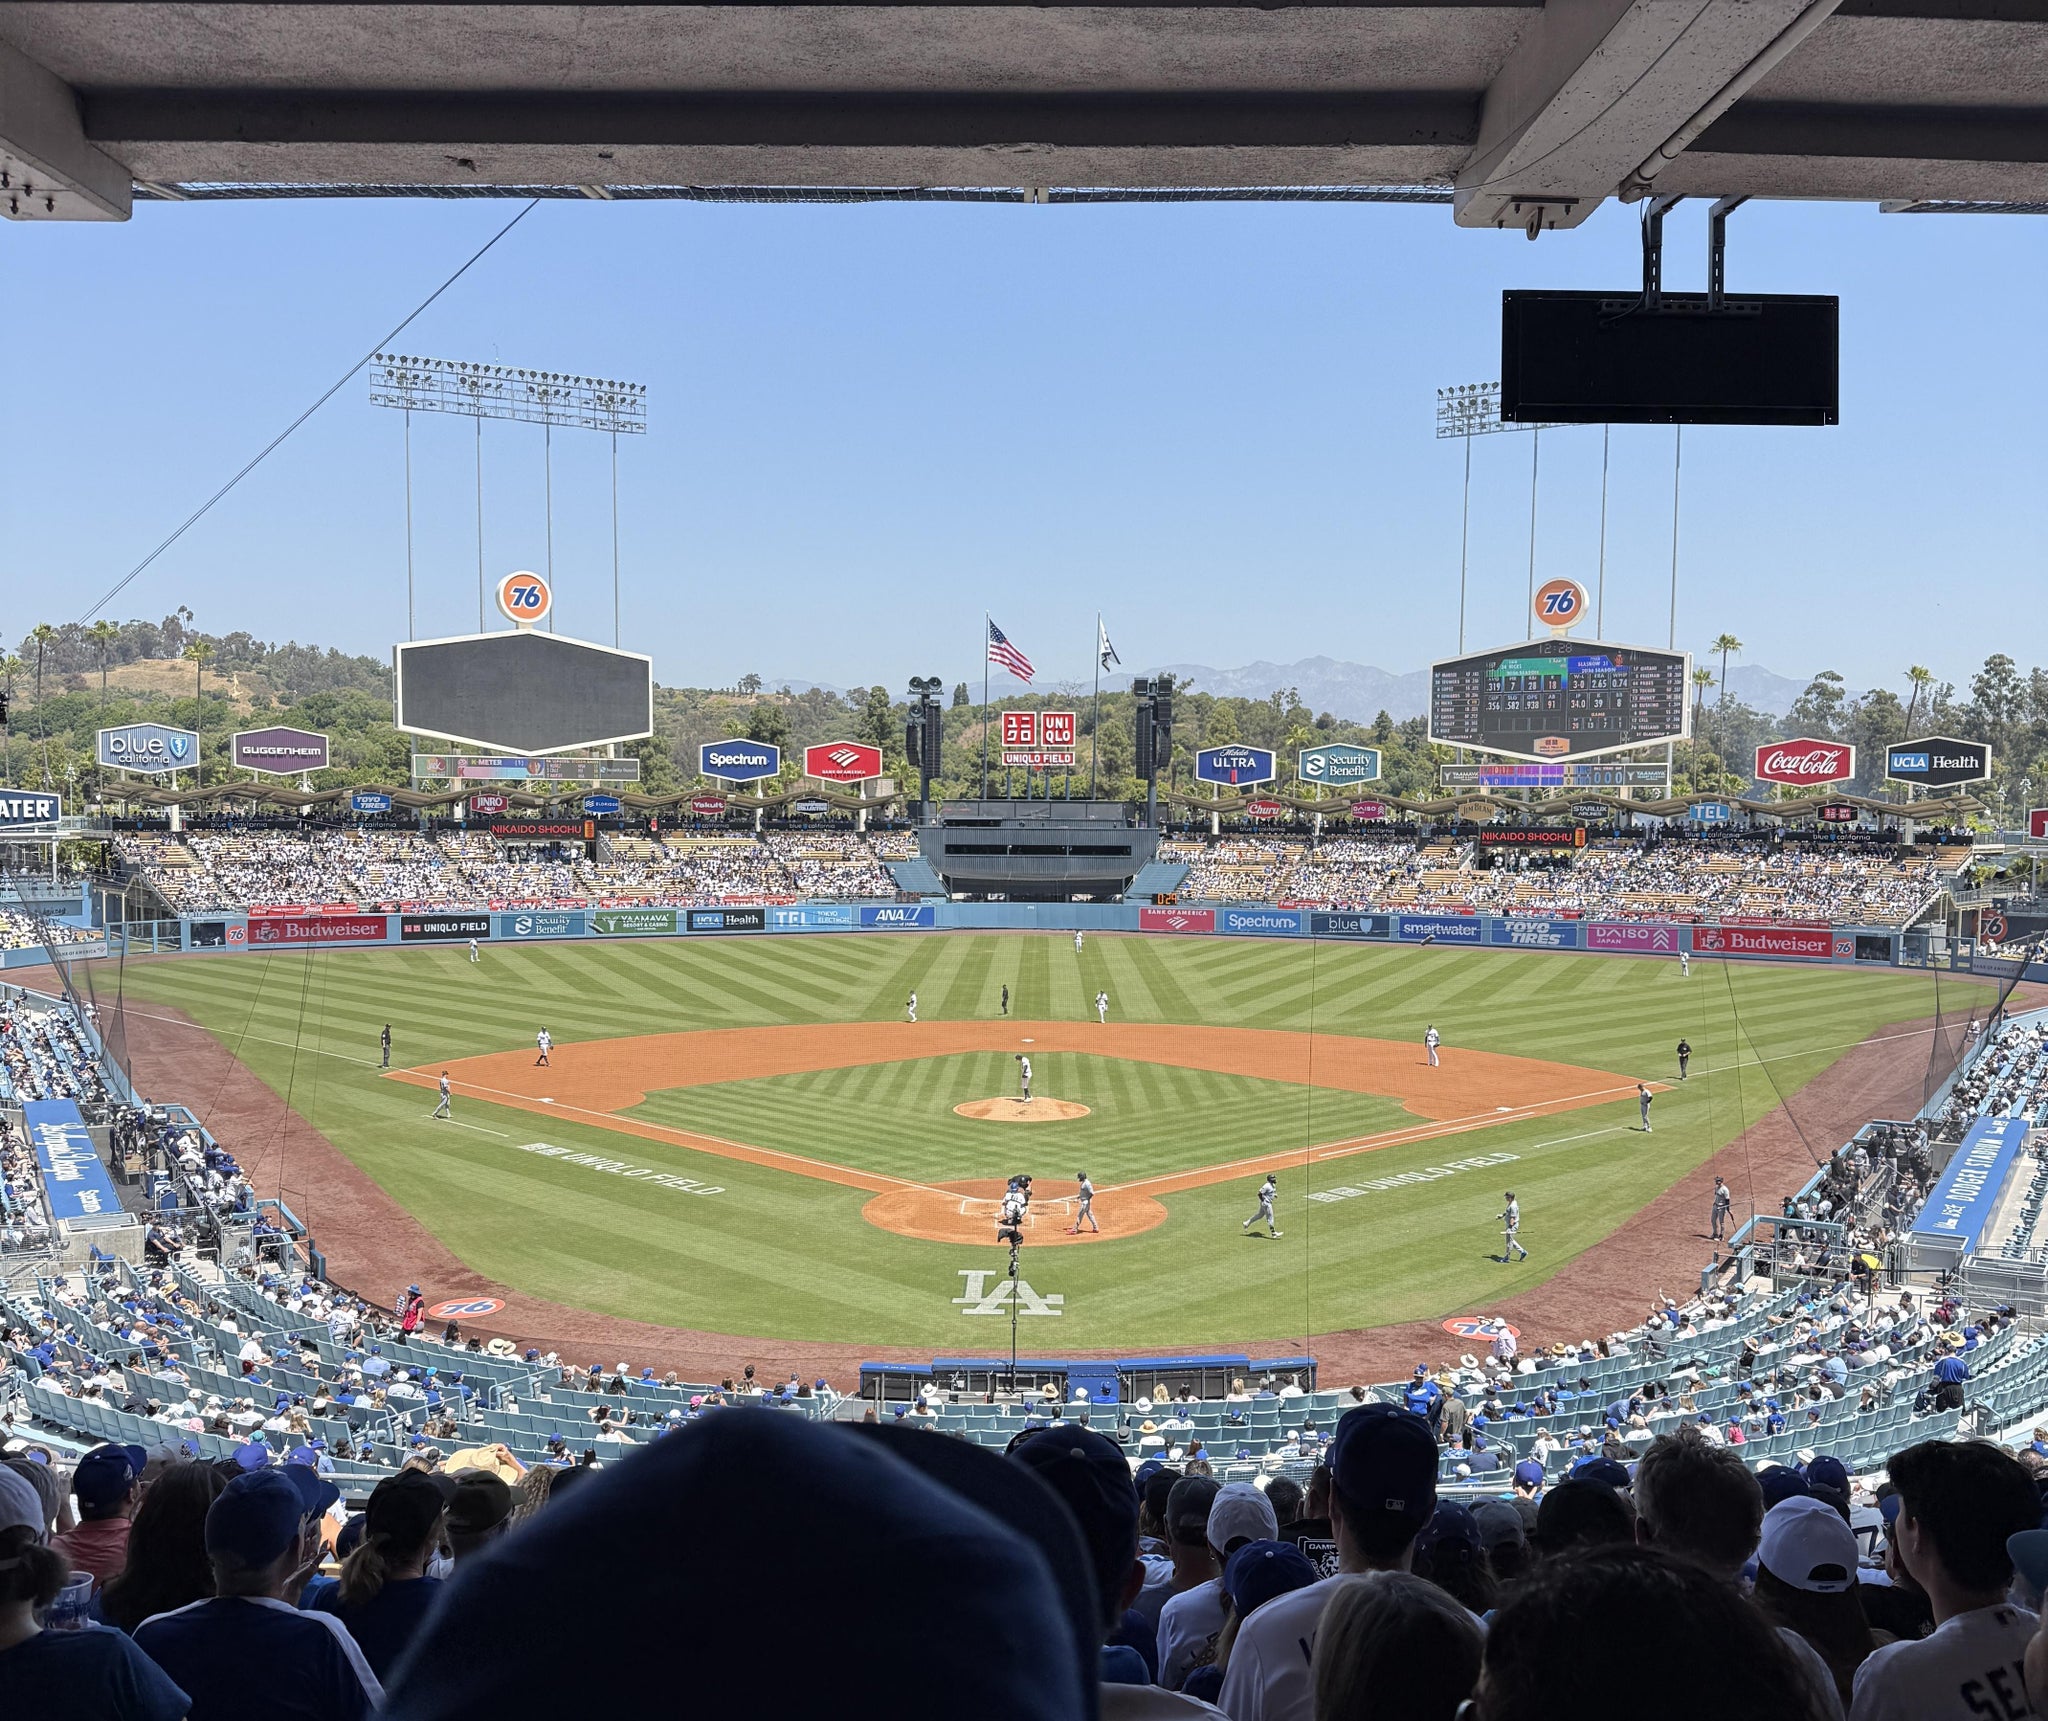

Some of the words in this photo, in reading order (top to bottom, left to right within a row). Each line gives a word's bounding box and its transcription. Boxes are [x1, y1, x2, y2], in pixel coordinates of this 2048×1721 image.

[511, 585, 541, 608] 76
[1543, 589, 1575, 615] 76
[1540, 643, 1573, 654] 12:28
[1486, 683, 1501, 692] .319
[1510, 682, 1516, 691] 7
[1528, 682, 1537, 690] 28
[1592, 680, 1607, 688] 2.65
[1612, 679, 1628, 687] 0.74
[1485, 701, 1500, 710] .356
[1505, 701, 1520, 710] .582
[1525, 701, 1539, 710] .938
[1594, 699, 1603, 708] 39
[1007, 716, 1032, 728] ユニ
[1045, 717, 1069, 729] UNI
[1006, 730, 1031, 741] クロ
[1045, 730, 1071, 743] QLO
[110, 731, 164, 754] blue
[242, 746, 321, 756] GUGGENHEIM
[118, 754, 170, 764] california
[709, 753, 768, 767] Spectrum
[1006, 754, 1041, 765] UNIQLO
[1043, 754, 1071, 763] FIELD
[1213, 757, 1256, 768] ULTRA
[1329, 754, 1371, 766] Security
[1763, 750, 1843, 775] Coca-Cola
[1893, 757, 1926, 768] UCLA
[1933, 756, 1979, 769] Health
[1329, 765, 1366, 776] Benefit
[1594, 772, 1601, 784] 0
[1604, 772, 1611, 784] 0
[1615, 772, 1622, 784] 0
[477, 797, 503, 807] JINRO
[693, 801, 724, 809] Yakult
[1249, 803, 1280, 815] Churu
[1461, 805, 1474, 817] JIM
[1474, 803, 1493, 815] BEAM
[1694, 805, 1725, 819] TEL
[492, 825, 536, 834] NIKAIDO
[538, 825, 582, 834] SHOCHU
[1481, 832, 1525, 841] NIKAIDO
[1527, 832, 1573, 842] SHOCHU
[536, 914, 571, 925] Security
[697, 916, 720, 926] UCLA
[726, 915, 759, 926] Health
[775, 911, 811, 927] TEL
[875, 909, 904, 921] ANA
[424, 923, 458, 933] UNIQLO
[461, 922, 488, 931] FIELD
[1229, 914, 1293, 929] Spectrum
[1329, 917, 1358, 930] blue
[1504, 921, 1550, 933] TOYO
[229, 929, 245, 940] 76
[285, 923, 379, 938] Budweiser
[536, 924, 566, 934] Benefit
[1404, 923, 1477, 937] smartwater
[1596, 928, 1649, 939] DAISO
[1511, 933, 1561, 945] TIRES
[1730, 932, 1827, 952] Budweiser
[1836, 942, 1852, 954] 76
[562, 1152, 653, 1176] UNIQLO
[641, 1173, 726, 1195] FIELD
[1357, 1167, 1455, 1190] UNIQLO
[1445, 1152, 1521, 1171] FIELD
[951, 1269, 1064, 1316] LA
[441, 1300, 496, 1316] 76
